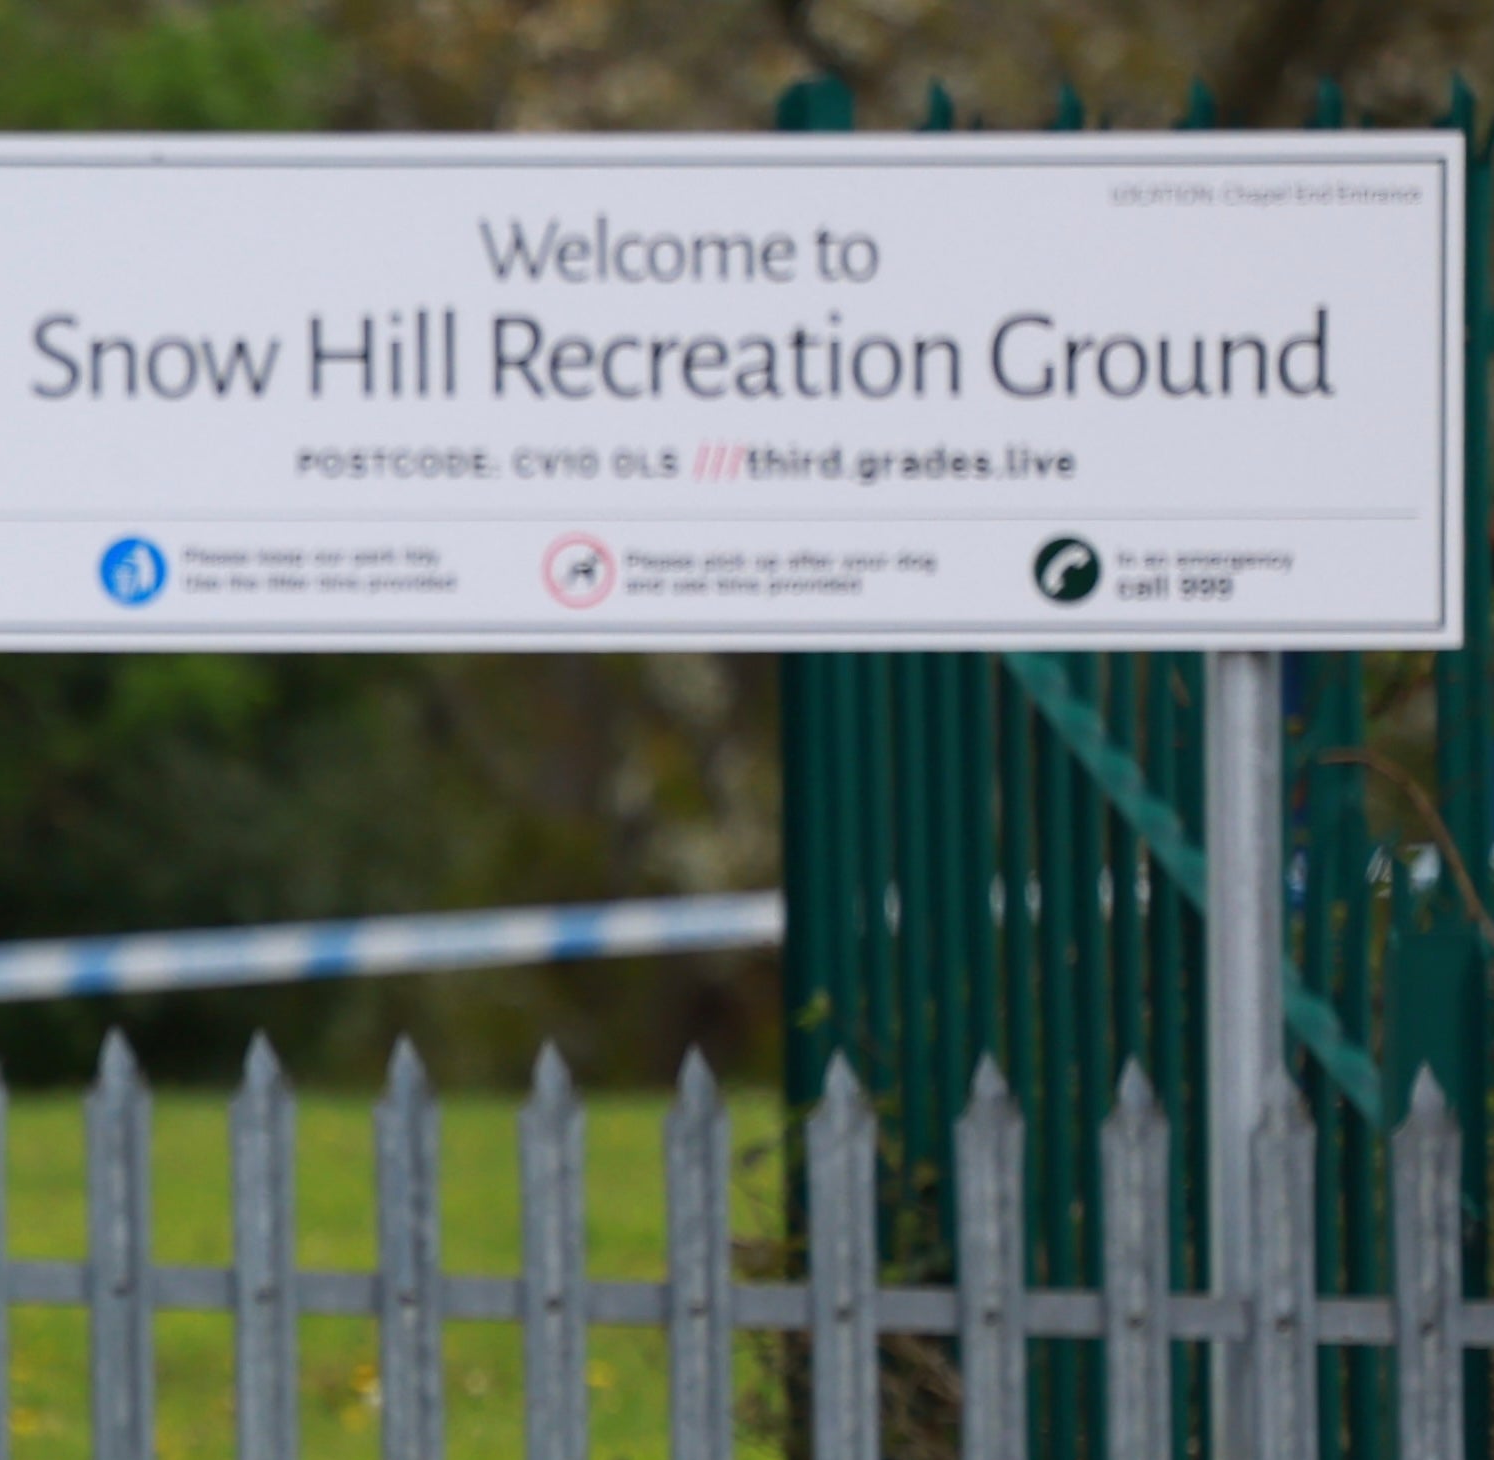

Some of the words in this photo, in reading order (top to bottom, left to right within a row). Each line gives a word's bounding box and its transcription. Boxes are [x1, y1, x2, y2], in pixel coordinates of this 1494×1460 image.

[479, 216, 796, 282] Welcome
[815, 229, 879, 282] to
[33, 314, 280, 399] Snow
[310, 309, 456, 396] Hill
[493, 314, 961, 398] Recreation
[991, 306, 1333, 398] Ground
[511, 448, 601, 479] CV10
[624, 551, 696, 573] Please
[1143, 554, 1168, 568] an
[1176, 553, 1294, 576] emergency
[1117, 577, 1169, 598] call
[1180, 576, 1234, 597] 999
